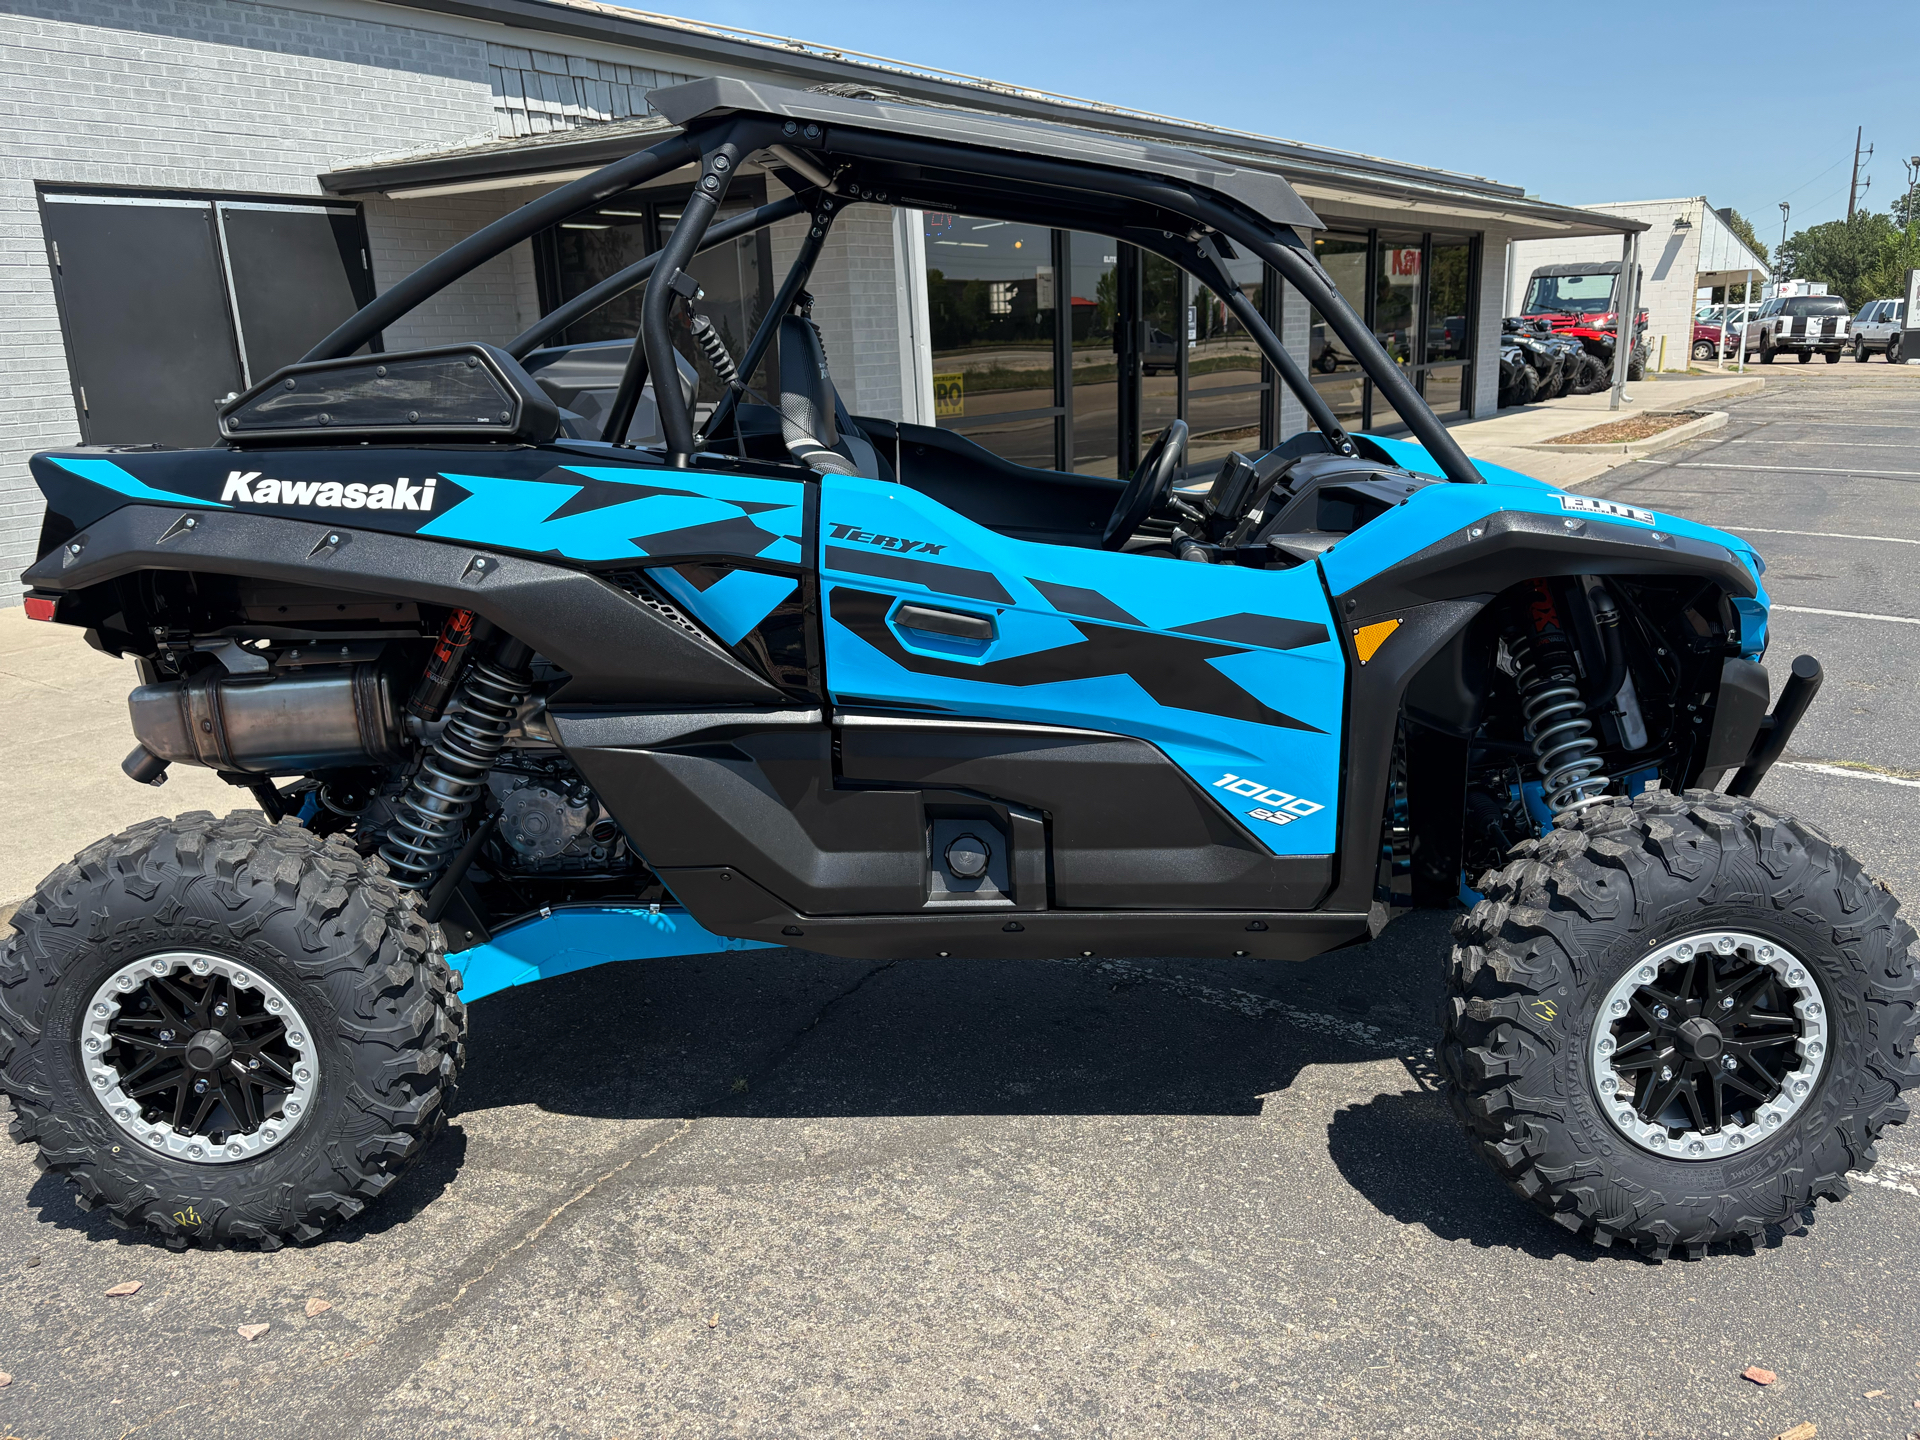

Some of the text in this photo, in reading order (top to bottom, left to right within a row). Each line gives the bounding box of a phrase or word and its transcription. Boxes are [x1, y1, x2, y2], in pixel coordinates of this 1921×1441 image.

[934, 382, 961, 407] RO
[221, 471, 437, 511] Kawasaki
[1212, 773, 1326, 816] 1000
